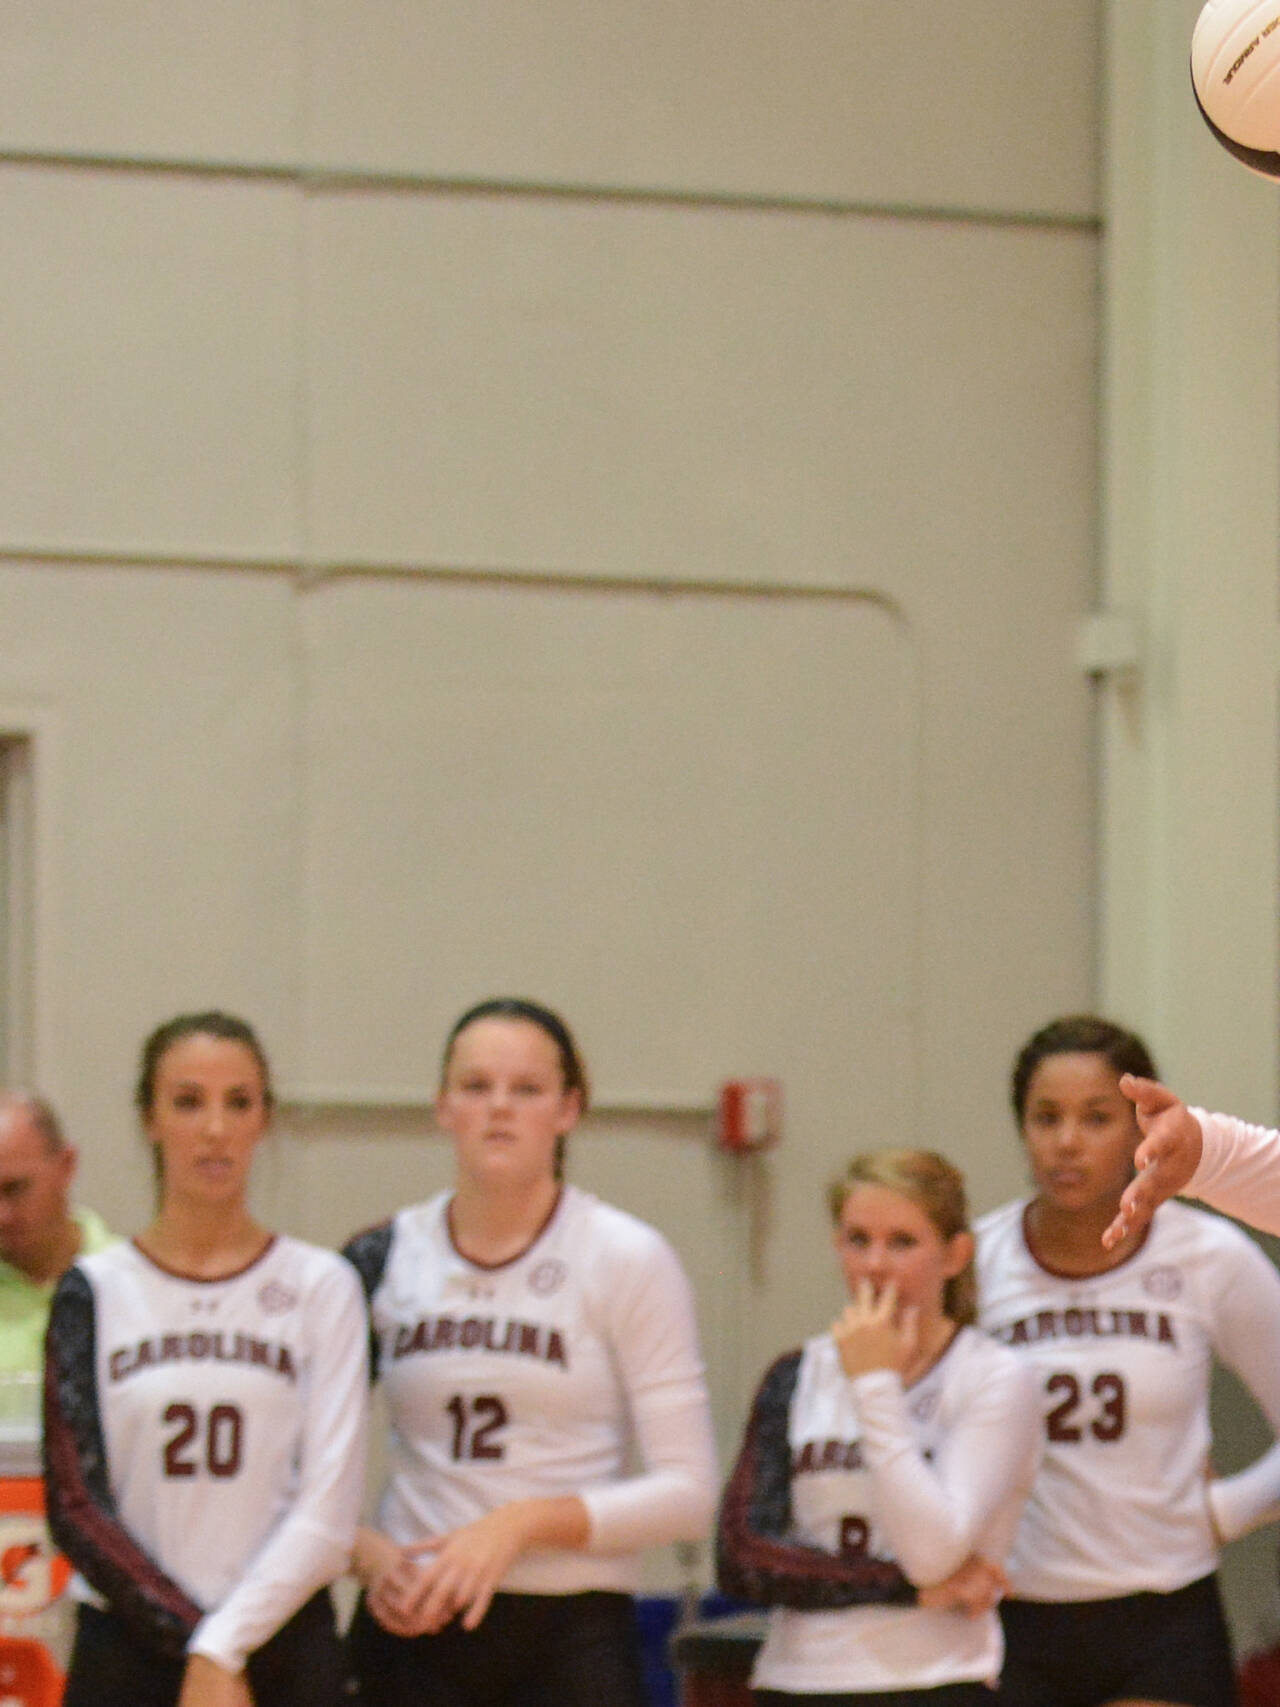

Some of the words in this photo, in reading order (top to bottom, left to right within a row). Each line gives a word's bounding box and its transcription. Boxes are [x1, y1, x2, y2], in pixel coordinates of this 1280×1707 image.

[1222, 35, 1260, 86] ARMOUR
[108, 1330, 297, 1387] CAROLINA
[163, 1402, 242, 1478] 20
[447, 1395, 509, 1463] 12
[1045, 1373, 1126, 1443] 23
